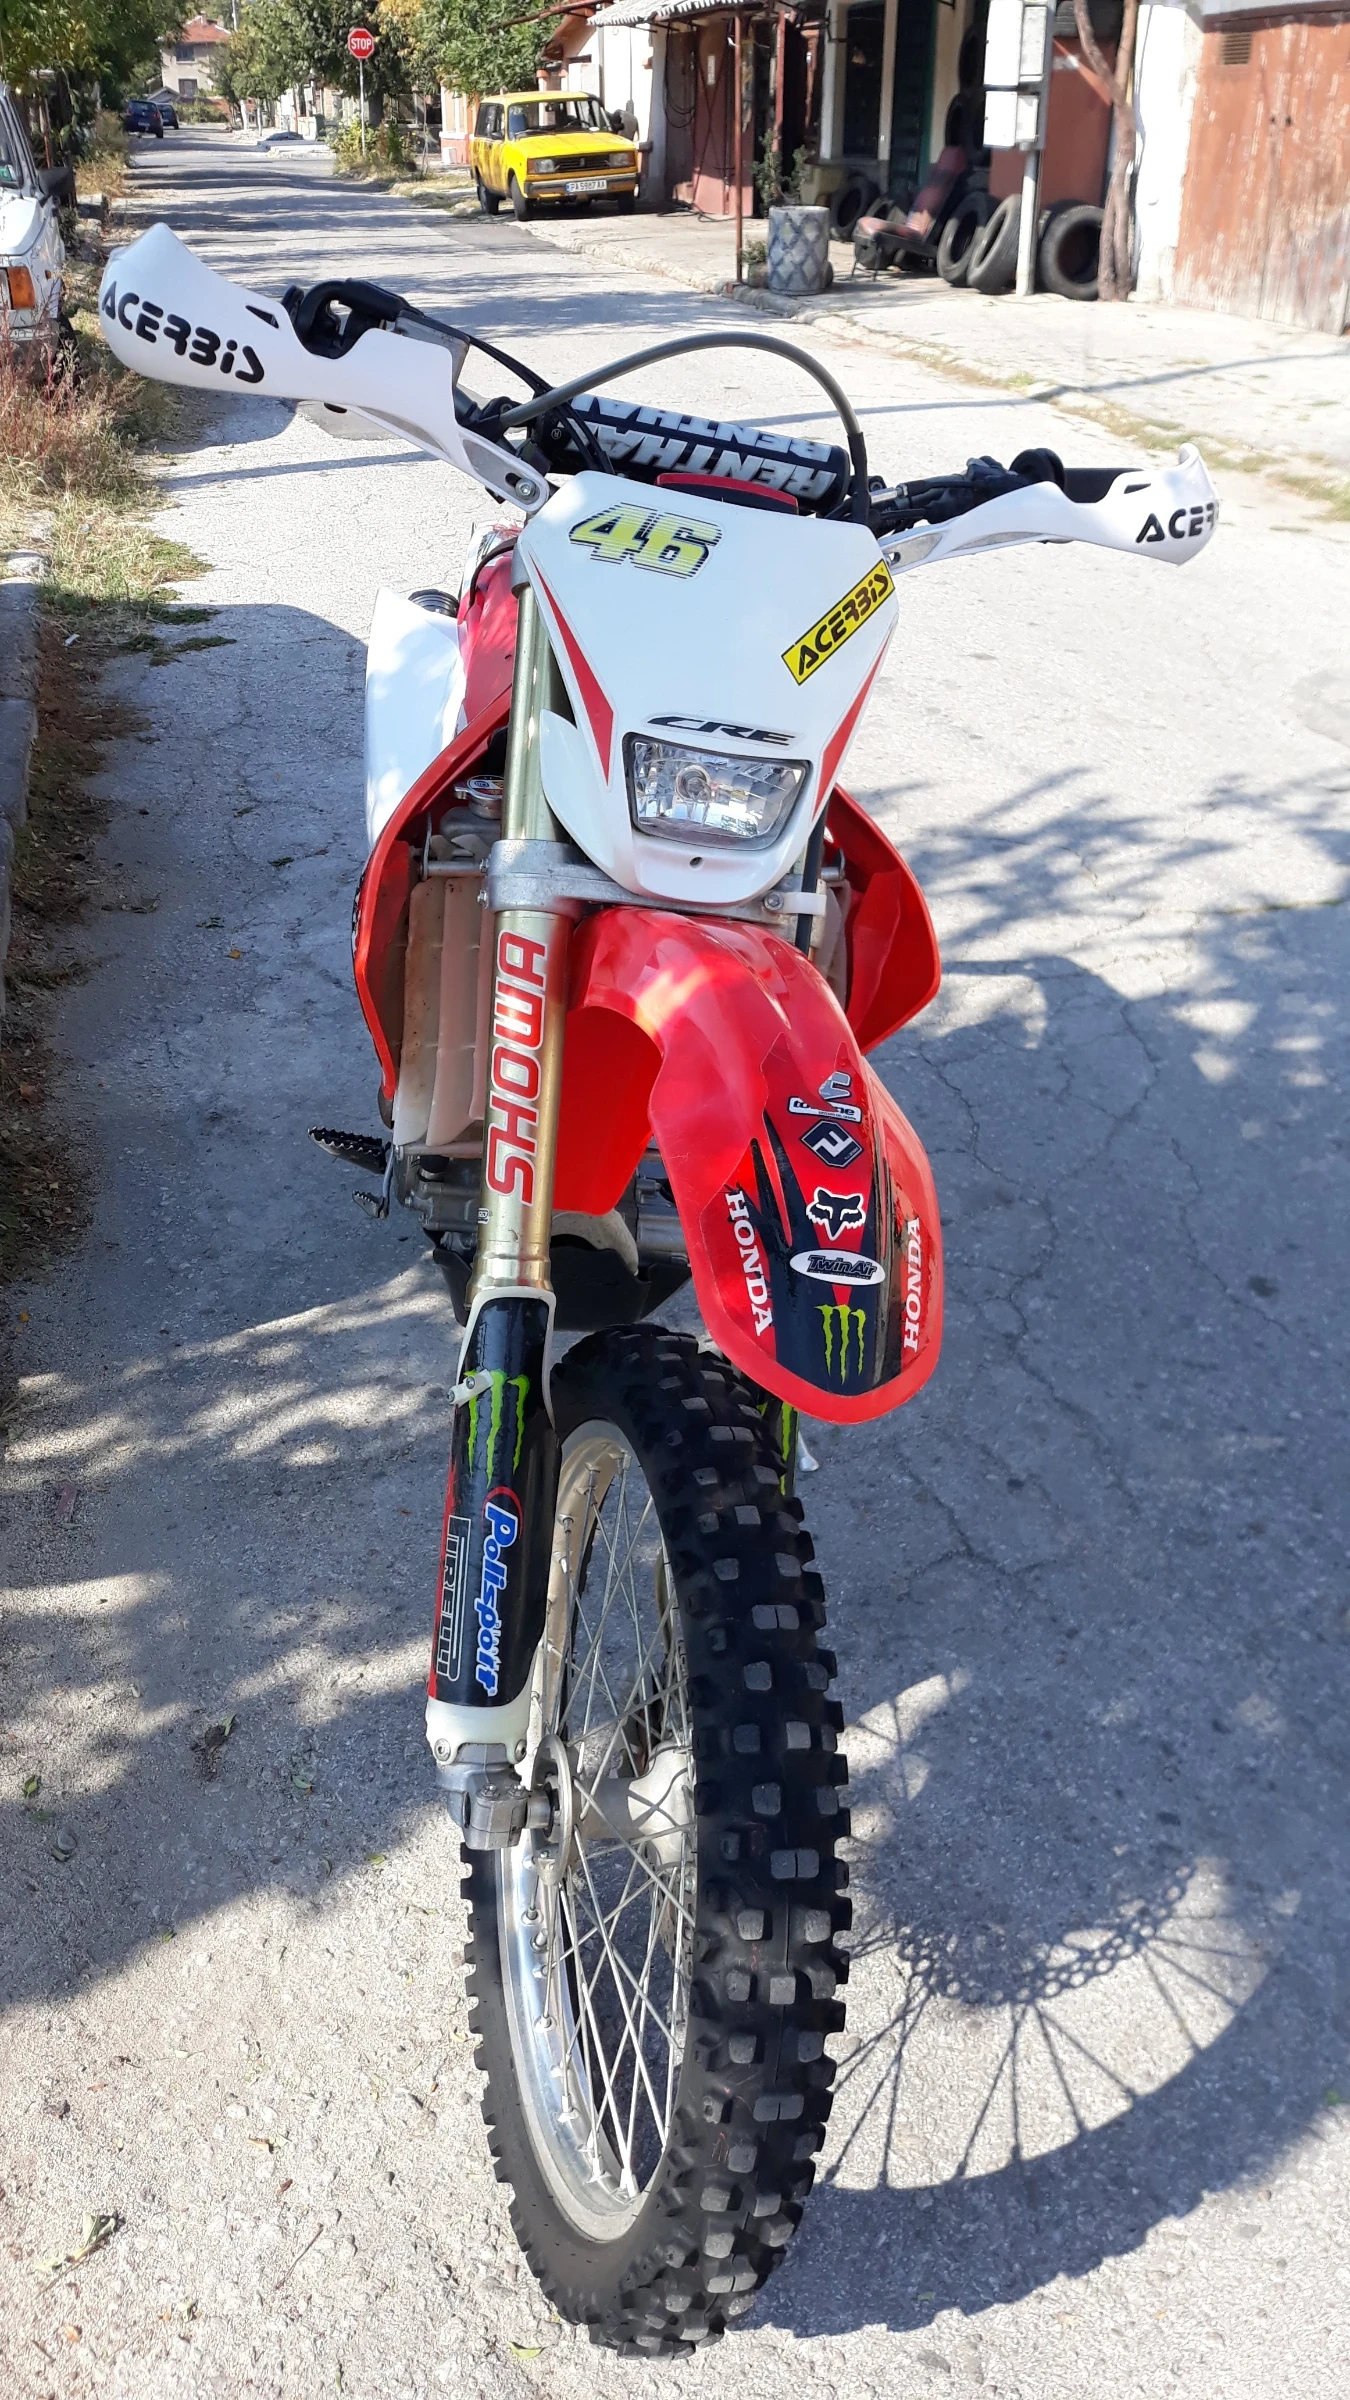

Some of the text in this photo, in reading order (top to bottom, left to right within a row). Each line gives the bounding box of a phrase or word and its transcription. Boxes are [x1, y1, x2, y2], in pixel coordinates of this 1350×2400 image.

[351, 37, 372, 50] STOP
[568, 501, 724, 580] 46
[1135, 502, 1219, 544] ACER
[647, 715, 796, 747] CRE
[486, 929, 548, 1207] SHOWA
[725, 1190, 774, 1337] HONDA
[904, 1216, 921, 1353] HONDA
[436, 1514, 472, 1682] PIRELLI
[474, 1502, 518, 1694] Polisport
